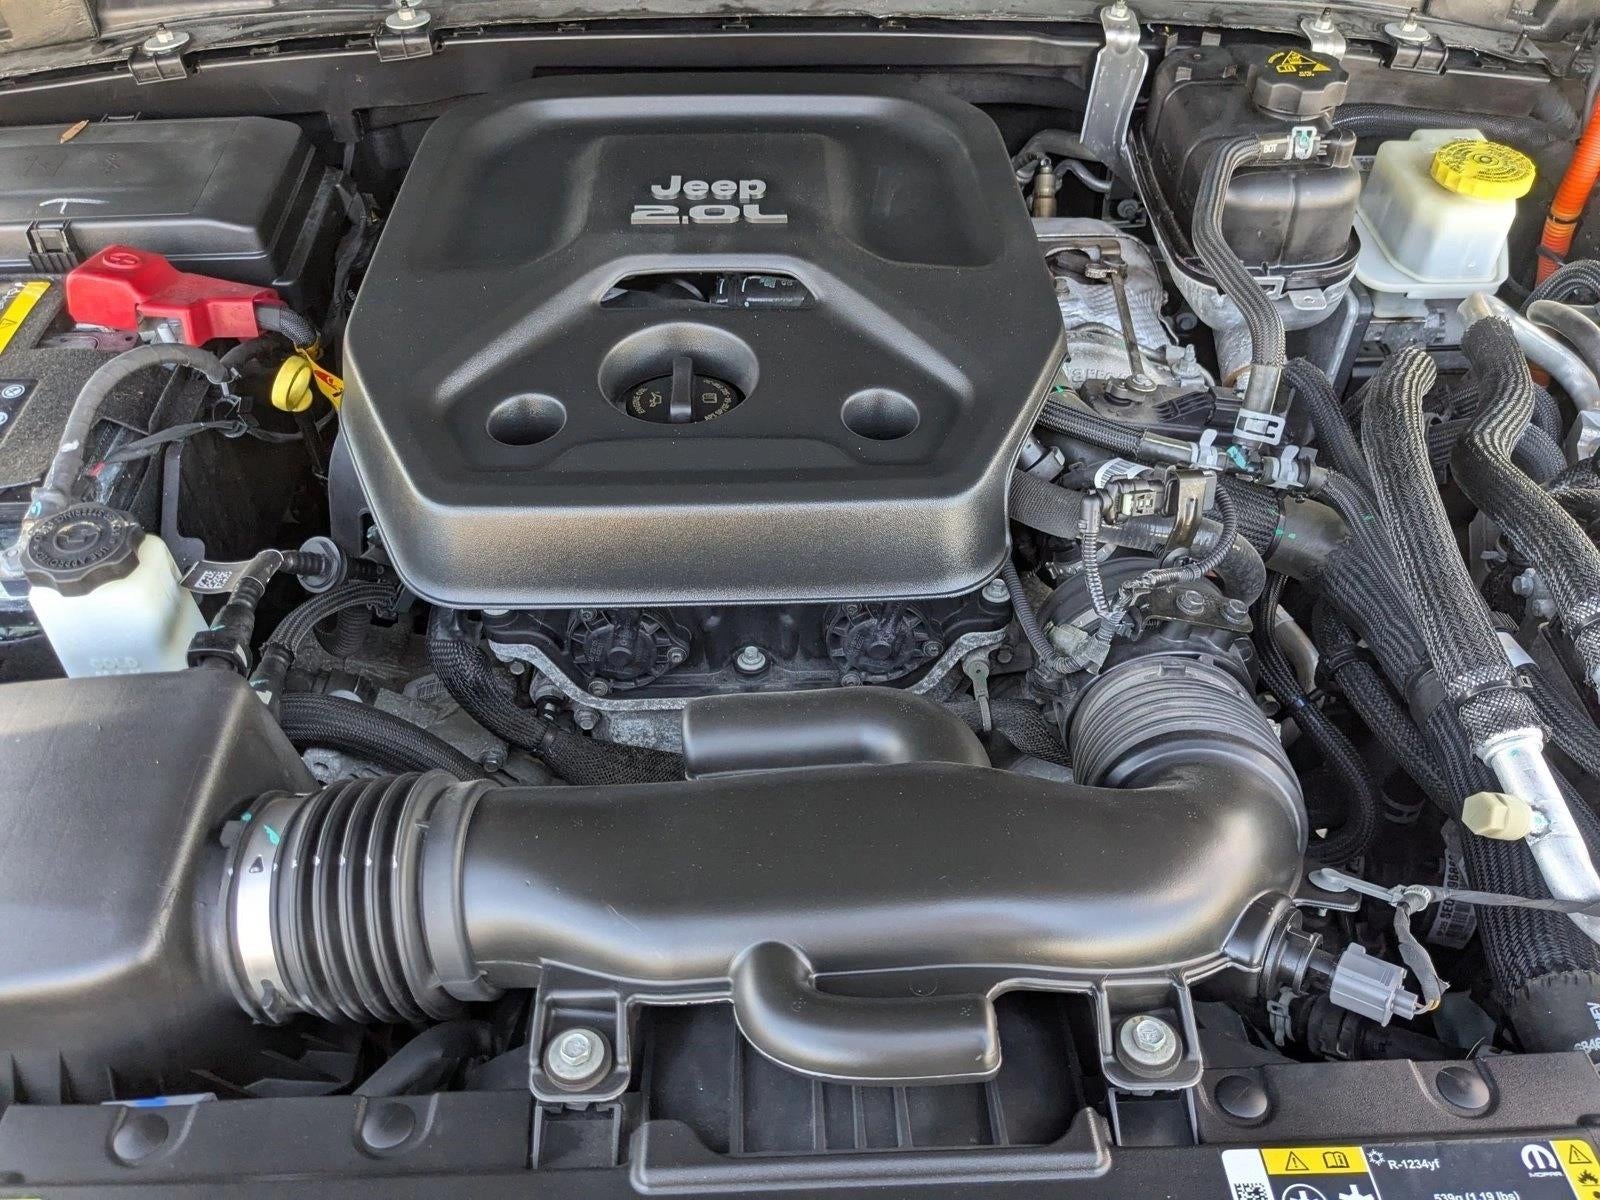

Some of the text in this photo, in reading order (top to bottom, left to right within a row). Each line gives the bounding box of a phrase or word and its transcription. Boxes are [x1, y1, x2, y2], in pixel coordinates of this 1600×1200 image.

[651, 175, 767, 203] Jeep
[630, 204, 788, 224] 2.0L
[1389, 1158, 1440, 1171] R-1234yf
